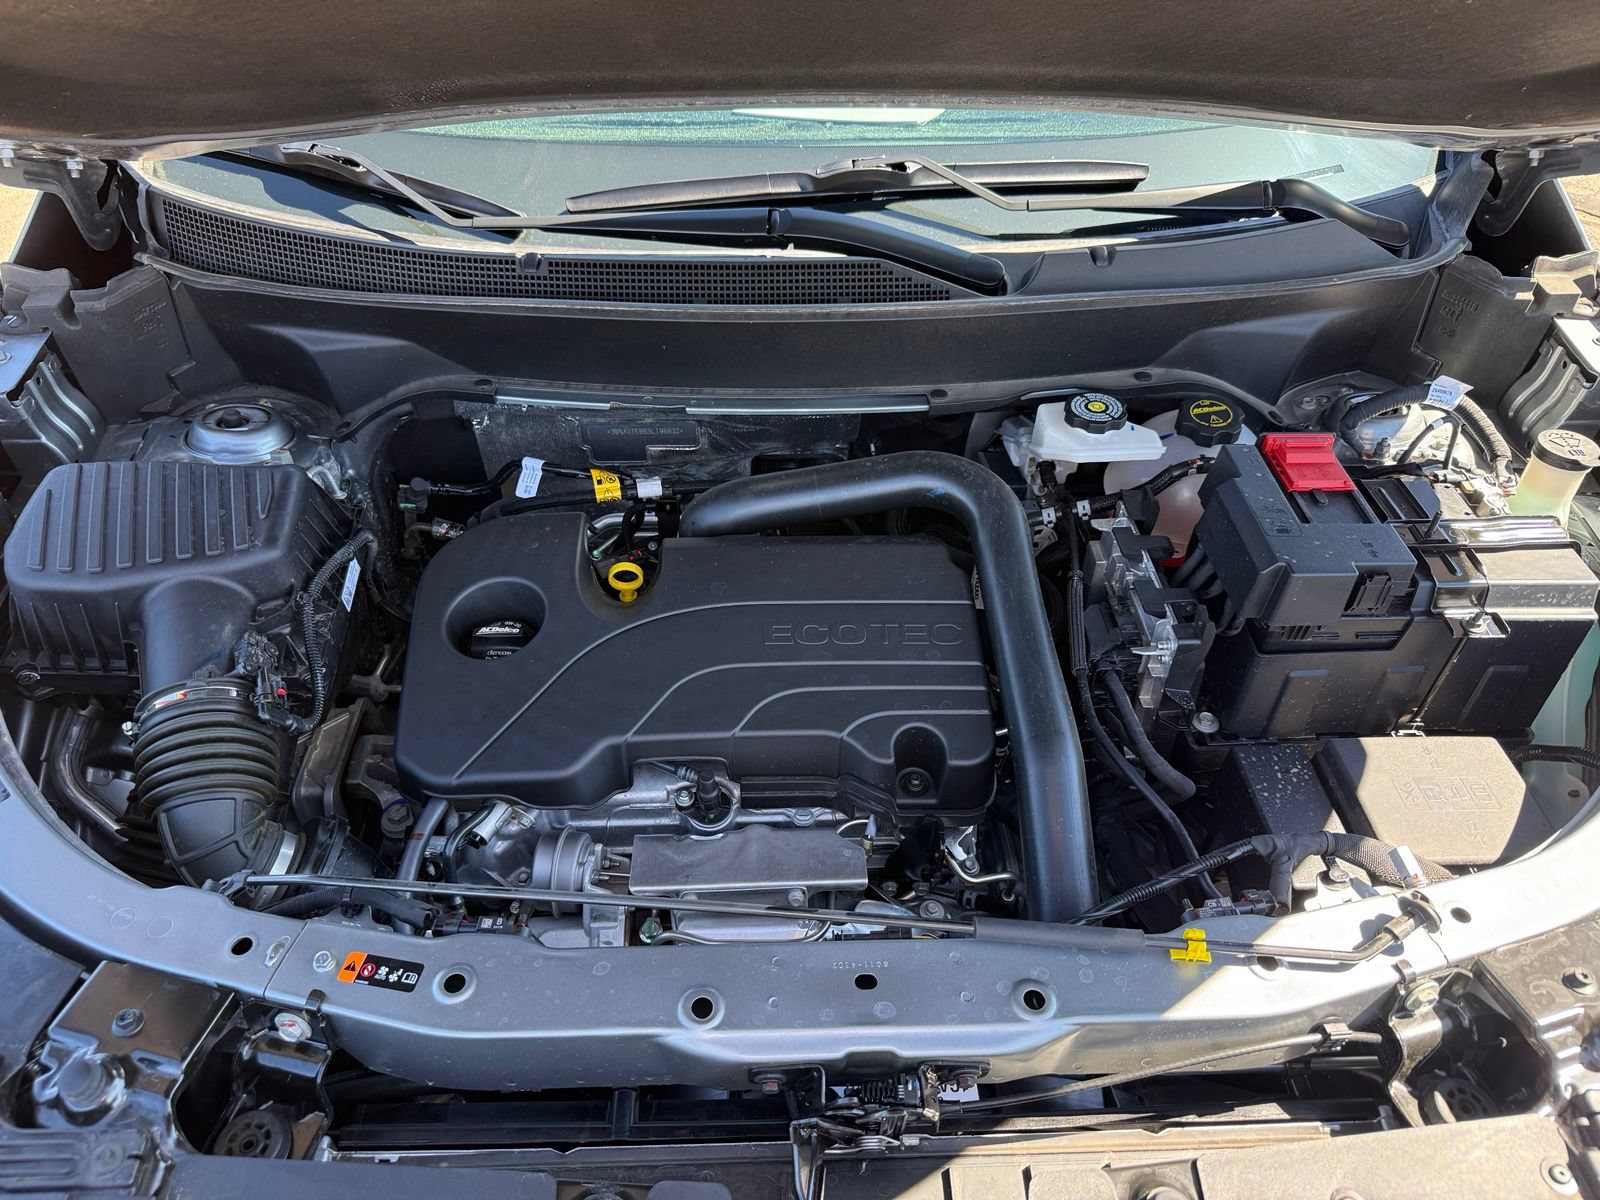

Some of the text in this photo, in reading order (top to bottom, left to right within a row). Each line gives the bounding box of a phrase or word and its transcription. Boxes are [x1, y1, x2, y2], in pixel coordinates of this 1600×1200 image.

[478, 626, 520, 634] ACDelco
[764, 623, 963, 645] ECOTEC
[496, 917, 503, 925] B
